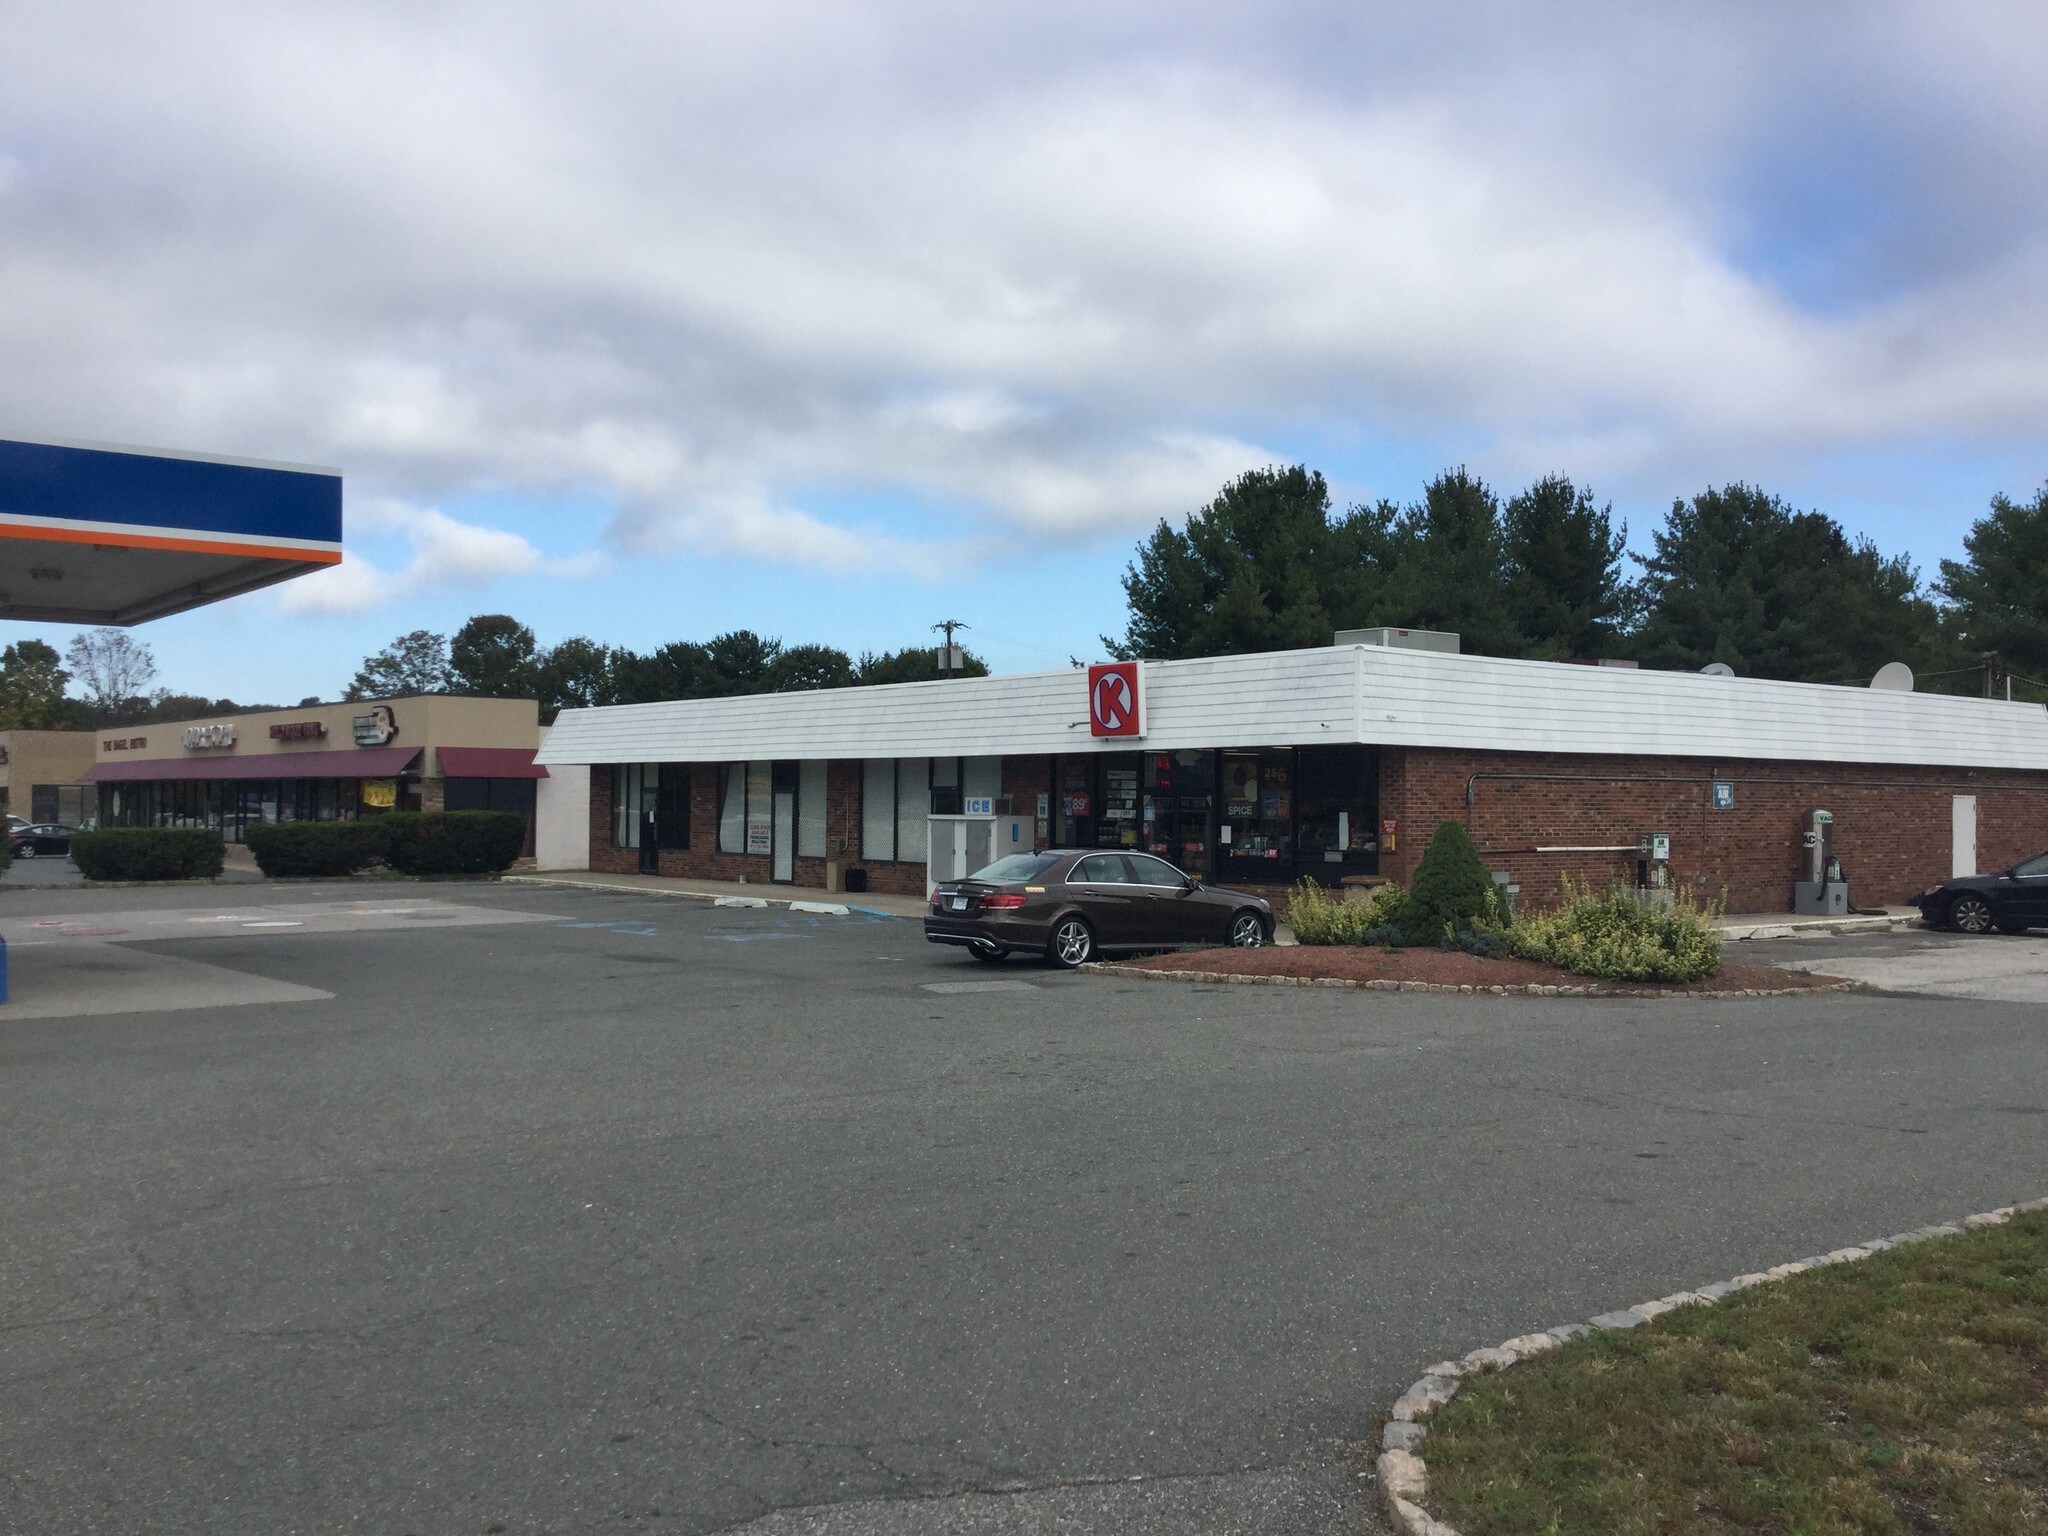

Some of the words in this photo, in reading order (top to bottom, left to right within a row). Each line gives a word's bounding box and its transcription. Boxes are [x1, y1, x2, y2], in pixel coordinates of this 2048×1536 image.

[1098, 677, 1130, 728] K
[1718, 789, 1730, 798] AIR
[967, 800, 990, 812] ICE
[1228, 805, 1253, 815] SPICE
